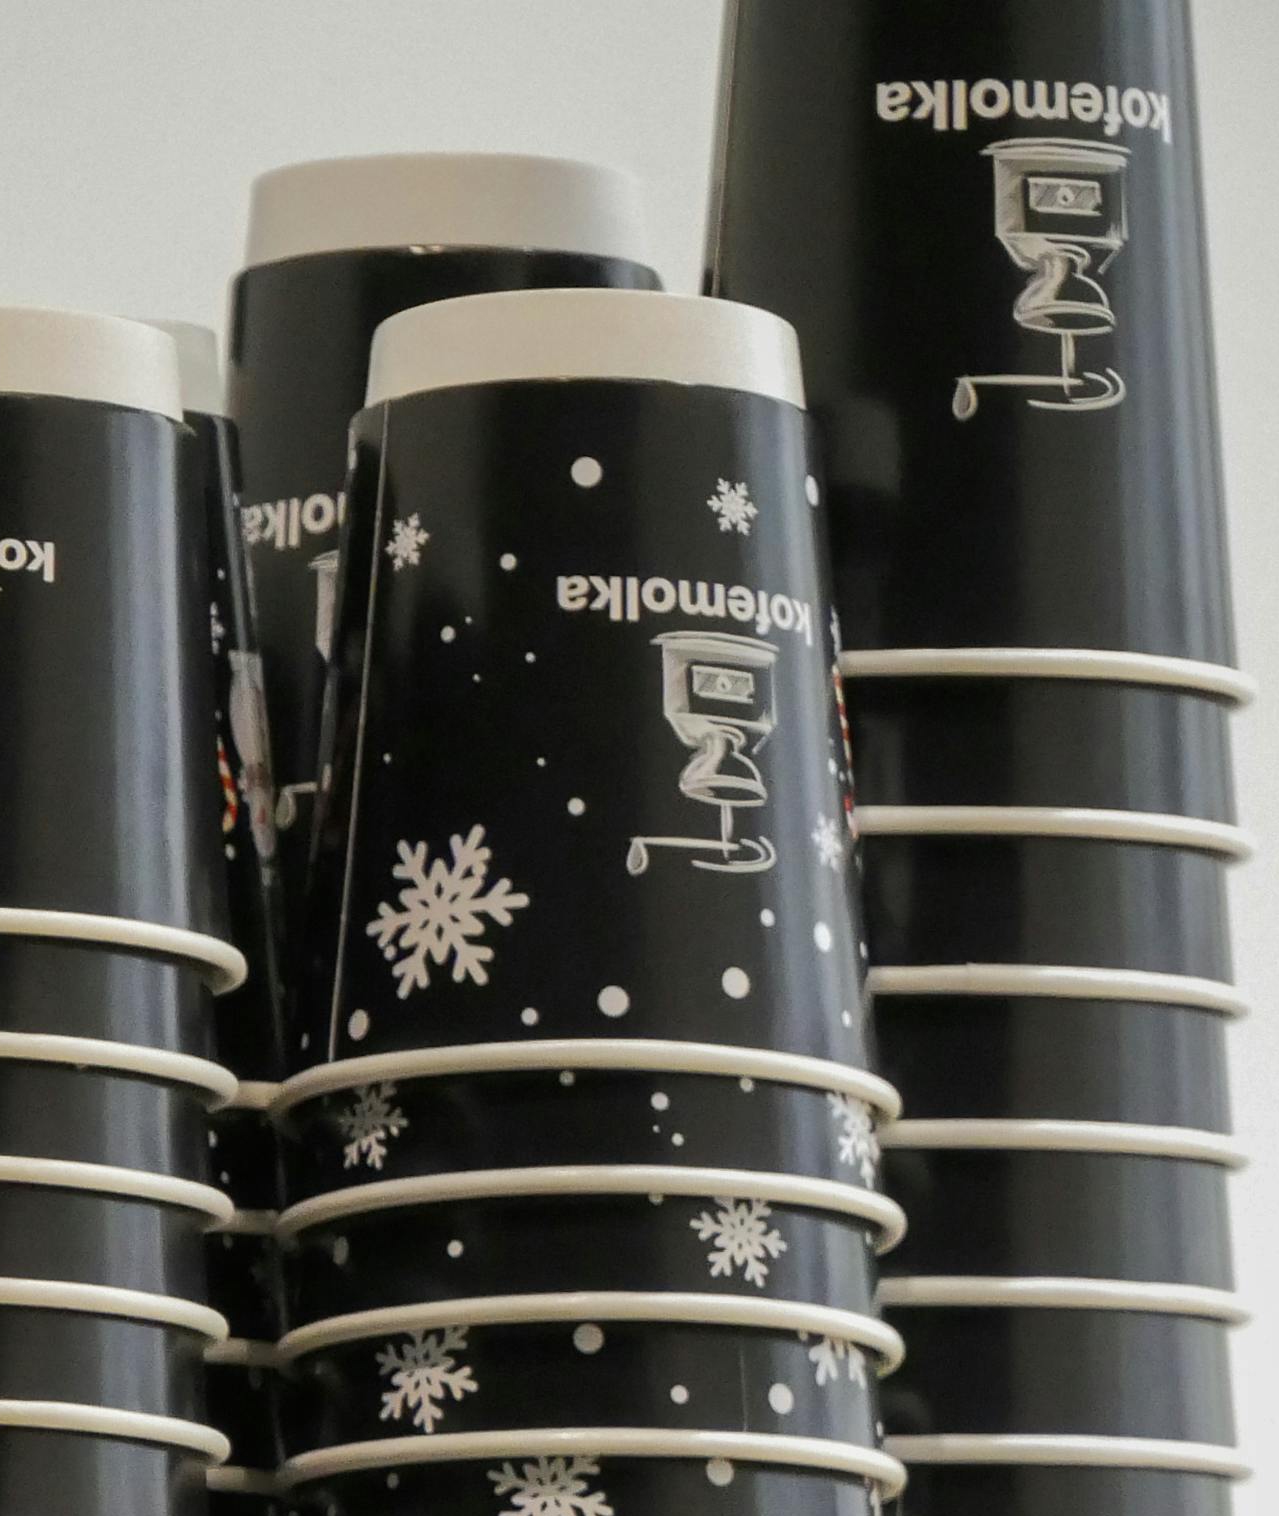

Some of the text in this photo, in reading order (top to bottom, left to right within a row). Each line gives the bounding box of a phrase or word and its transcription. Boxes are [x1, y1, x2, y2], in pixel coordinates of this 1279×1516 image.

[876, 77, 1173, 144] kofemolka
[240, 491, 347, 551] olka
[556, 574, 814, 647] kofemolka
